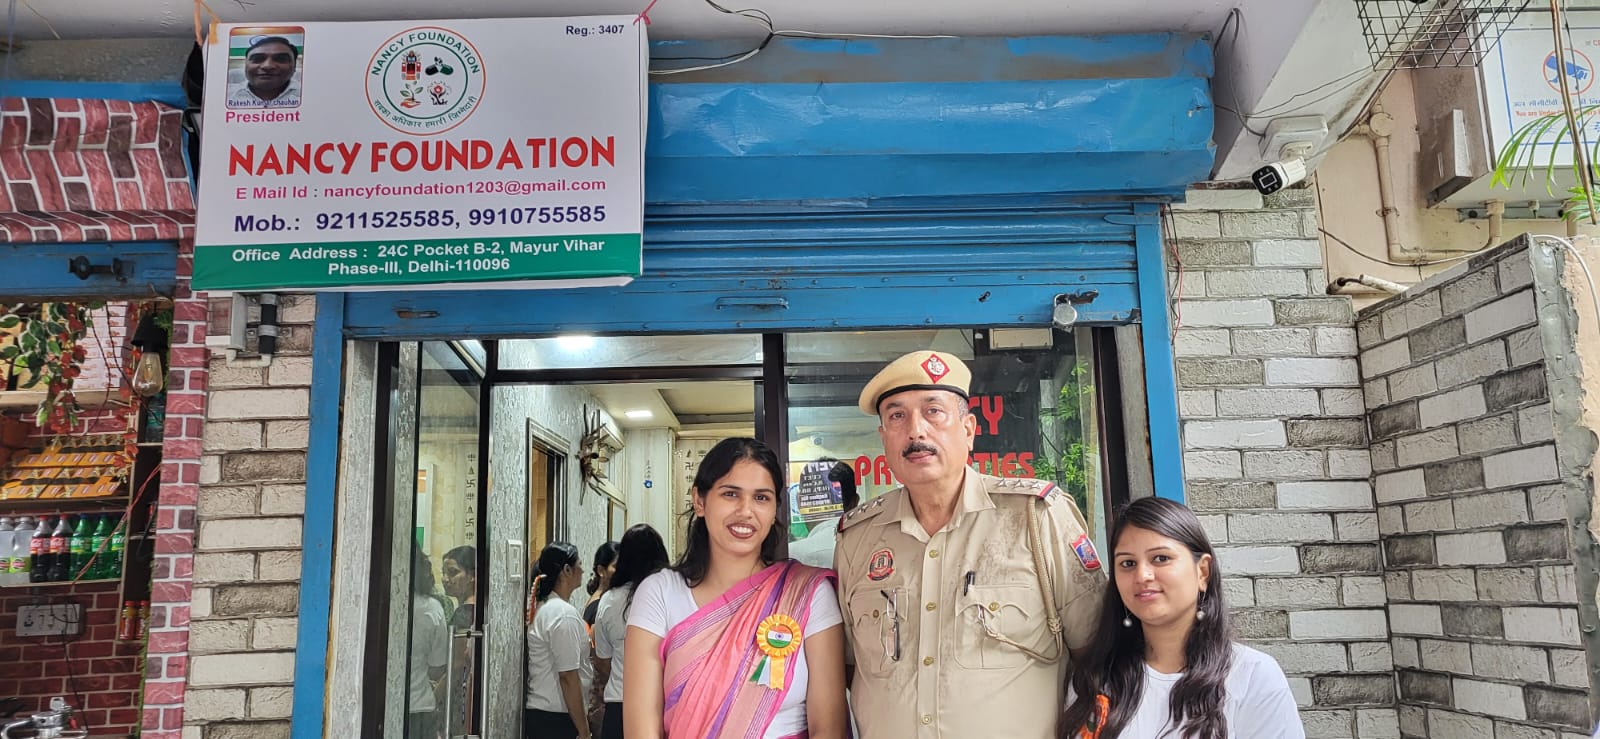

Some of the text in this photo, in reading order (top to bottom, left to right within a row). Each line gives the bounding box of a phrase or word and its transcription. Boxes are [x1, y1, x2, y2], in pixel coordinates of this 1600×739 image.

[566, 24, 625, 37] Reg.: 3407
[371, 31, 481, 76] NANCY FOUNDATION
[228, 99, 251, 107] Rakesh
[225, 110, 301, 123] President
[391, 114, 422, 128] अधिकार
[425, 116, 447, 128] हमारी
[228, 135, 615, 176] NANCY FOUNDATION
[235, 187, 247, 199] E
[253, 186, 287, 199] Mail
[292, 185, 308, 198] Id
[324, 179, 607, 199] nancyfoundation1203@gmail.com
[234, 205, 606, 232] Mob.: 9211525585, 9910755585
[232, 248, 281, 262] Office
[288, 247, 358, 260] Address
[377, 244, 408, 258] 24C
[413, 243, 469, 256] Pocket
[473, 241, 505, 255] B-2,
[509, 240, 560, 257] Mayur
[563, 238, 605, 252] Vihar
[327, 258, 511, 275] Phase-III, Delhi-110096
